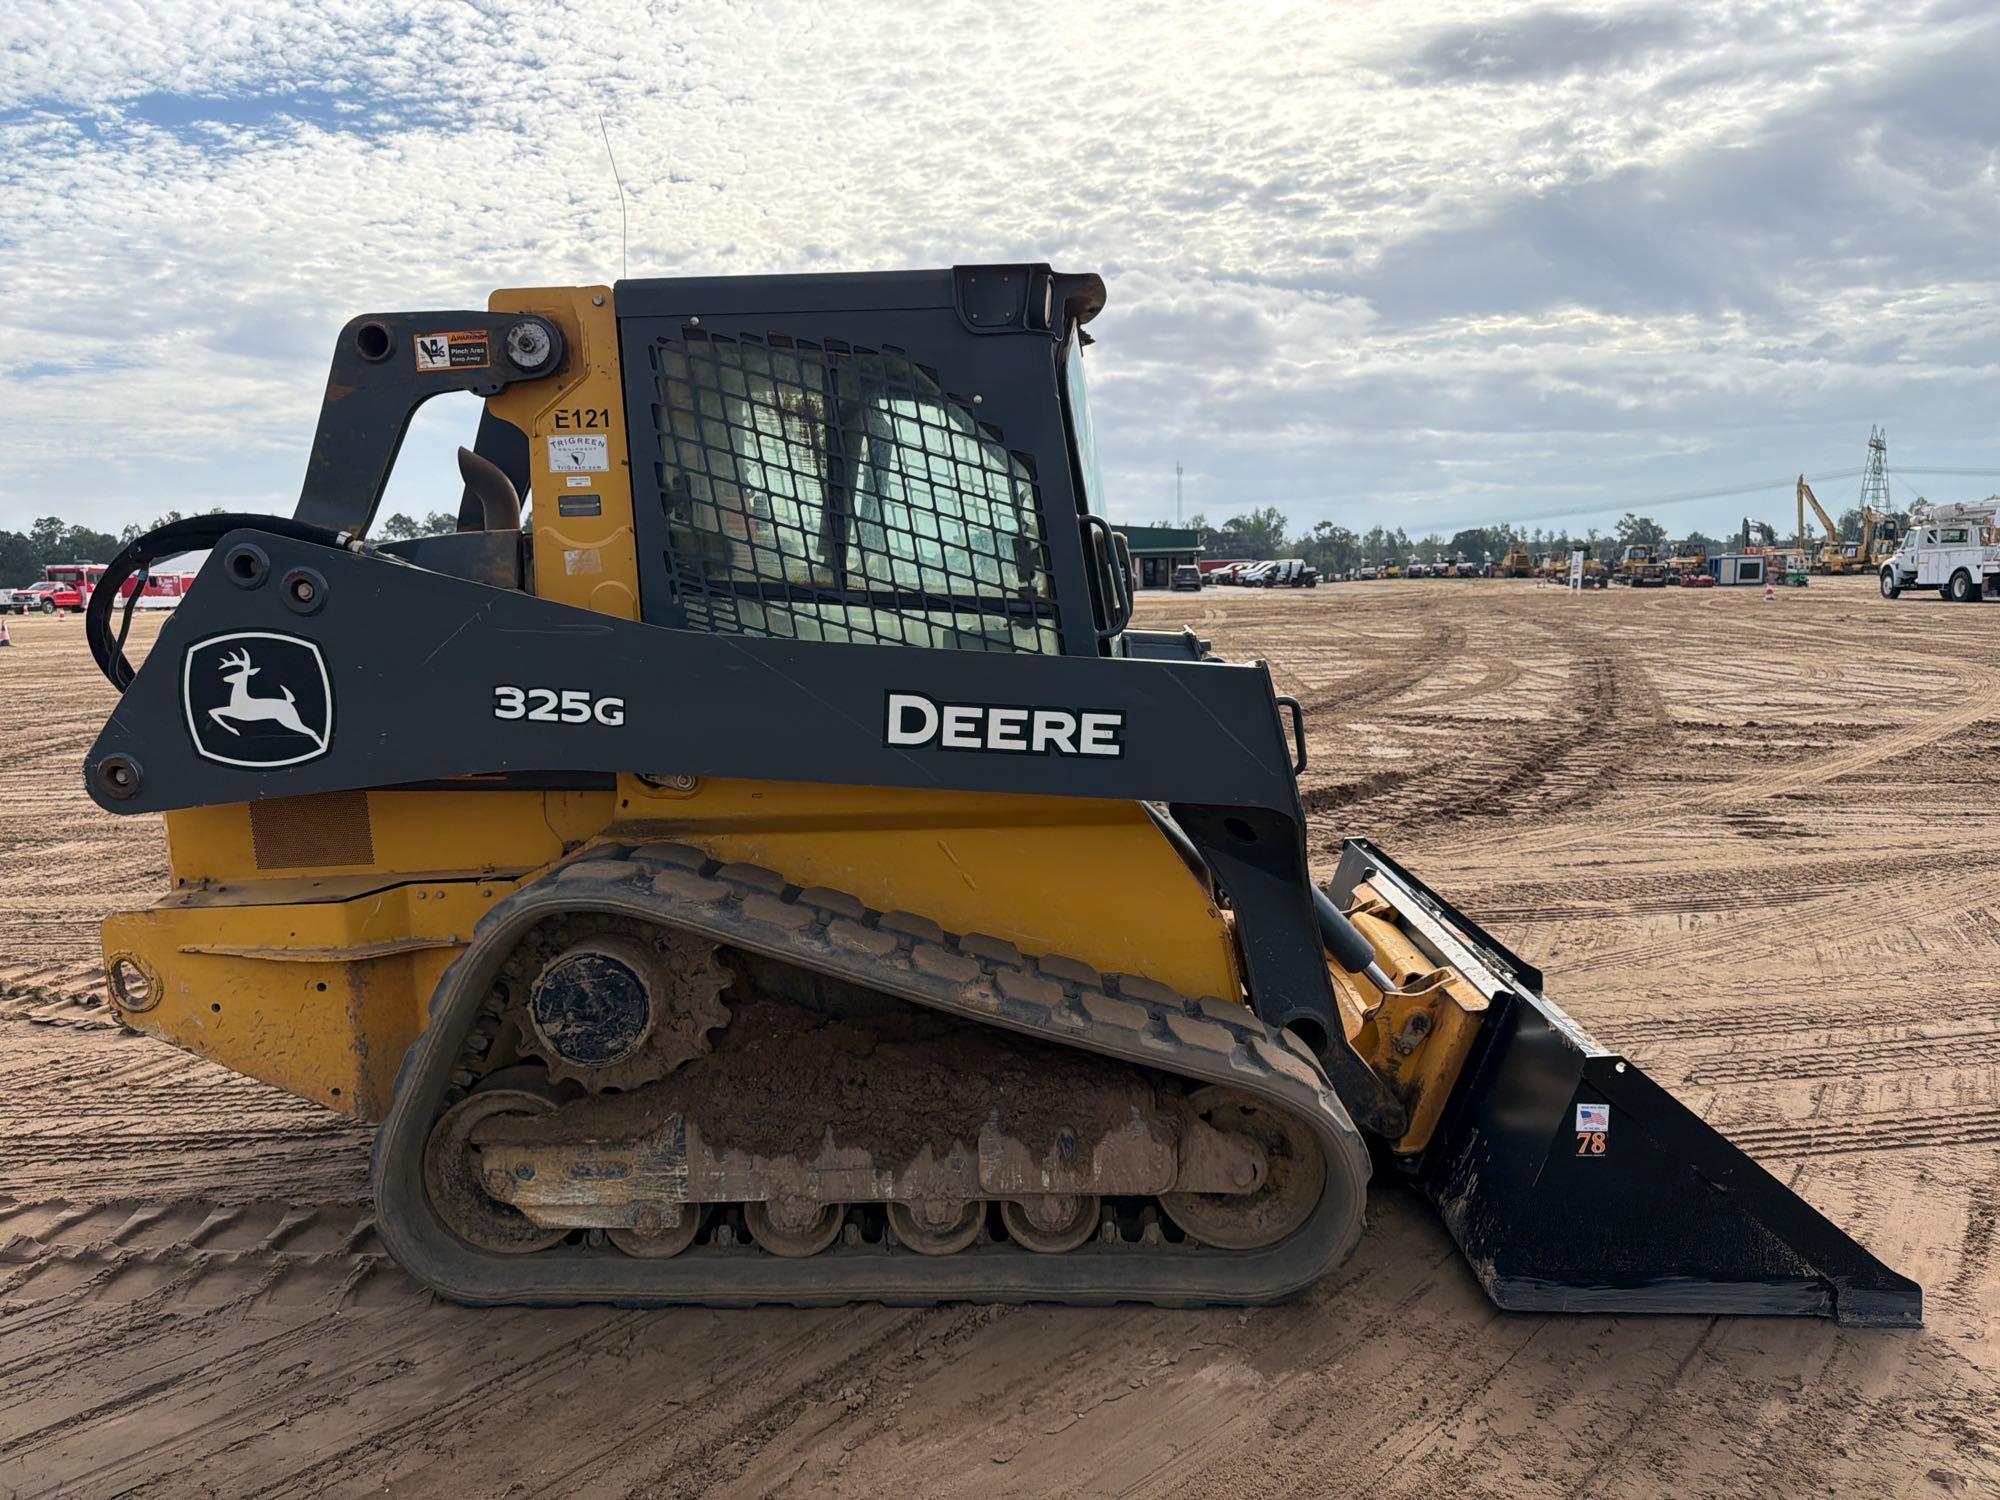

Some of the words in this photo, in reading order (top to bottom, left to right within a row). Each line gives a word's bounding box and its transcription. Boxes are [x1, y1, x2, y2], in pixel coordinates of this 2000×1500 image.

[555, 409, 609, 428] E121
[495, 686, 624, 726] 325G
[888, 694, 1122, 755] DEERE
[1576, 1132, 1606, 1154] 78
